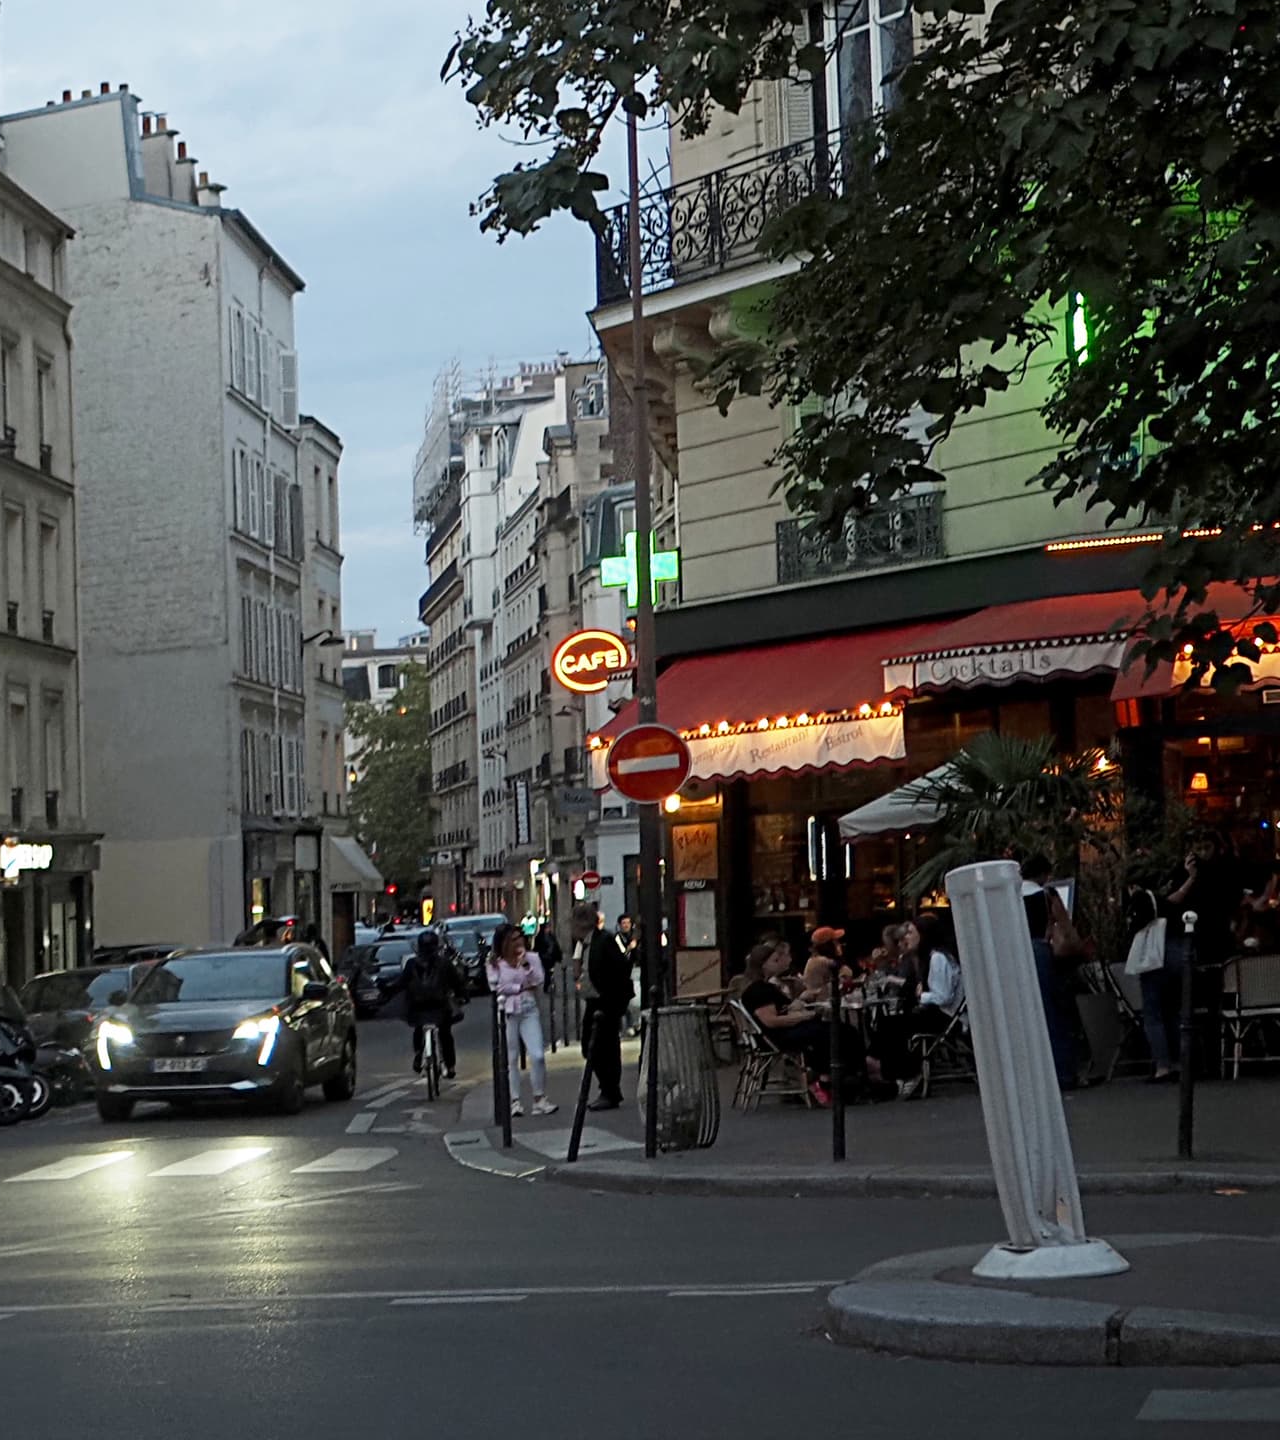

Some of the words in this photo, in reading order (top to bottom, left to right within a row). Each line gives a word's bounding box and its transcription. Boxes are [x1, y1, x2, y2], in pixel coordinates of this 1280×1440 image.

[930, 649, 1052, 681] Cocktails
[691, 738, 736, 767] omptoir
[749, 728, 810, 763] Restaurant
[824, 725, 865, 752] Bistrot
